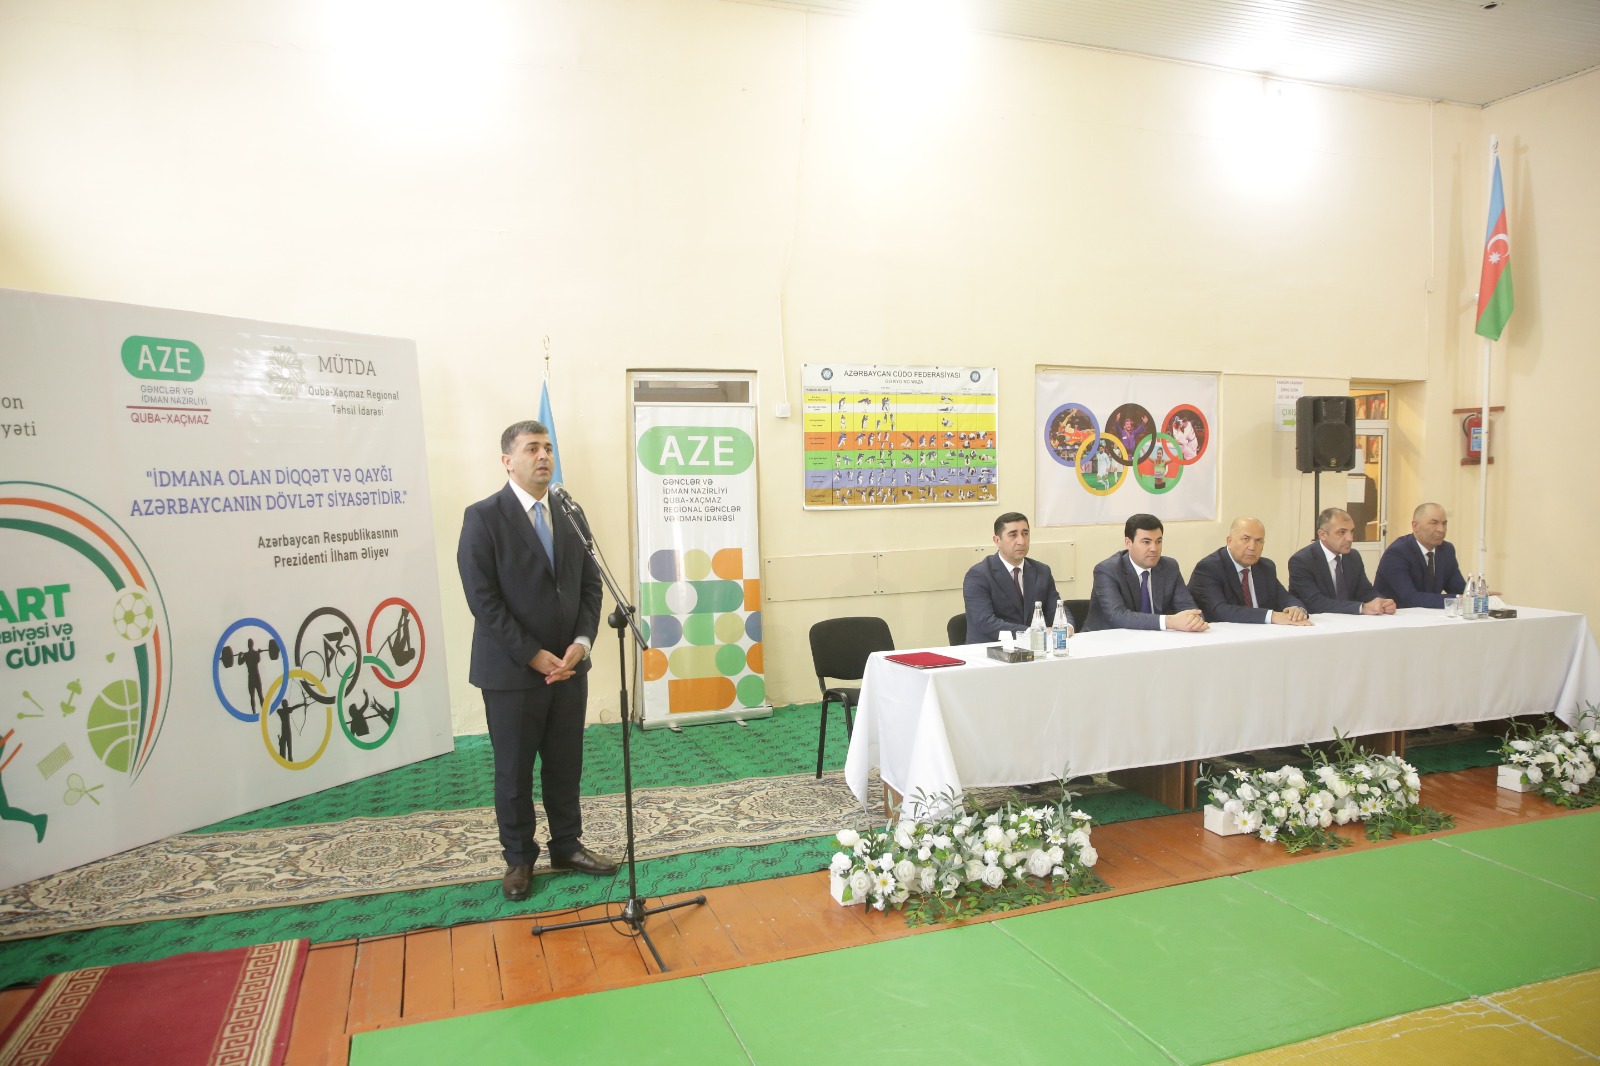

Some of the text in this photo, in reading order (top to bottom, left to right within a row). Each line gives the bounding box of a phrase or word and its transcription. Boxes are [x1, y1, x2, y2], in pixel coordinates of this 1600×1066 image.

[137, 344, 192, 375] AZE
[318, 353, 377, 377] MÜTDA
[140, 384, 194, 396] GƏNCLƏR VƏ
[308, 385, 400, 402] Quba-Xaçmaz Regional
[130, 412, 210, 427] QUBA-XAÇMAZ
[331, 404, 356, 416] Təhsil
[659, 435, 734, 466] AZE
[146, 464, 393, 488] "İDMANA OLAN DİQQƏT VƏ QAYĞI
[662, 478, 714, 486] GƏNCLƏR VƏ
[130, 495, 262, 517] AZƏRBAYCANIN
[265, 491, 324, 511] DÖVLƏT
[663, 496, 722, 505] QUBA-XAÇMAZ
[704, 505, 742, 513] GƏNCLƏR
[664, 515, 675, 523] VƏ
[704, 513, 735, 522] İDARƏSİ
[258, 528, 399, 549] Azərbaycan Respublikasının
[273, 547, 389, 569] Prezidenti İlham Əliyev
[0, 622, 74, 644] BİYƏSİ VƏ
[6, 636, 75, 669] GÜNÜ
